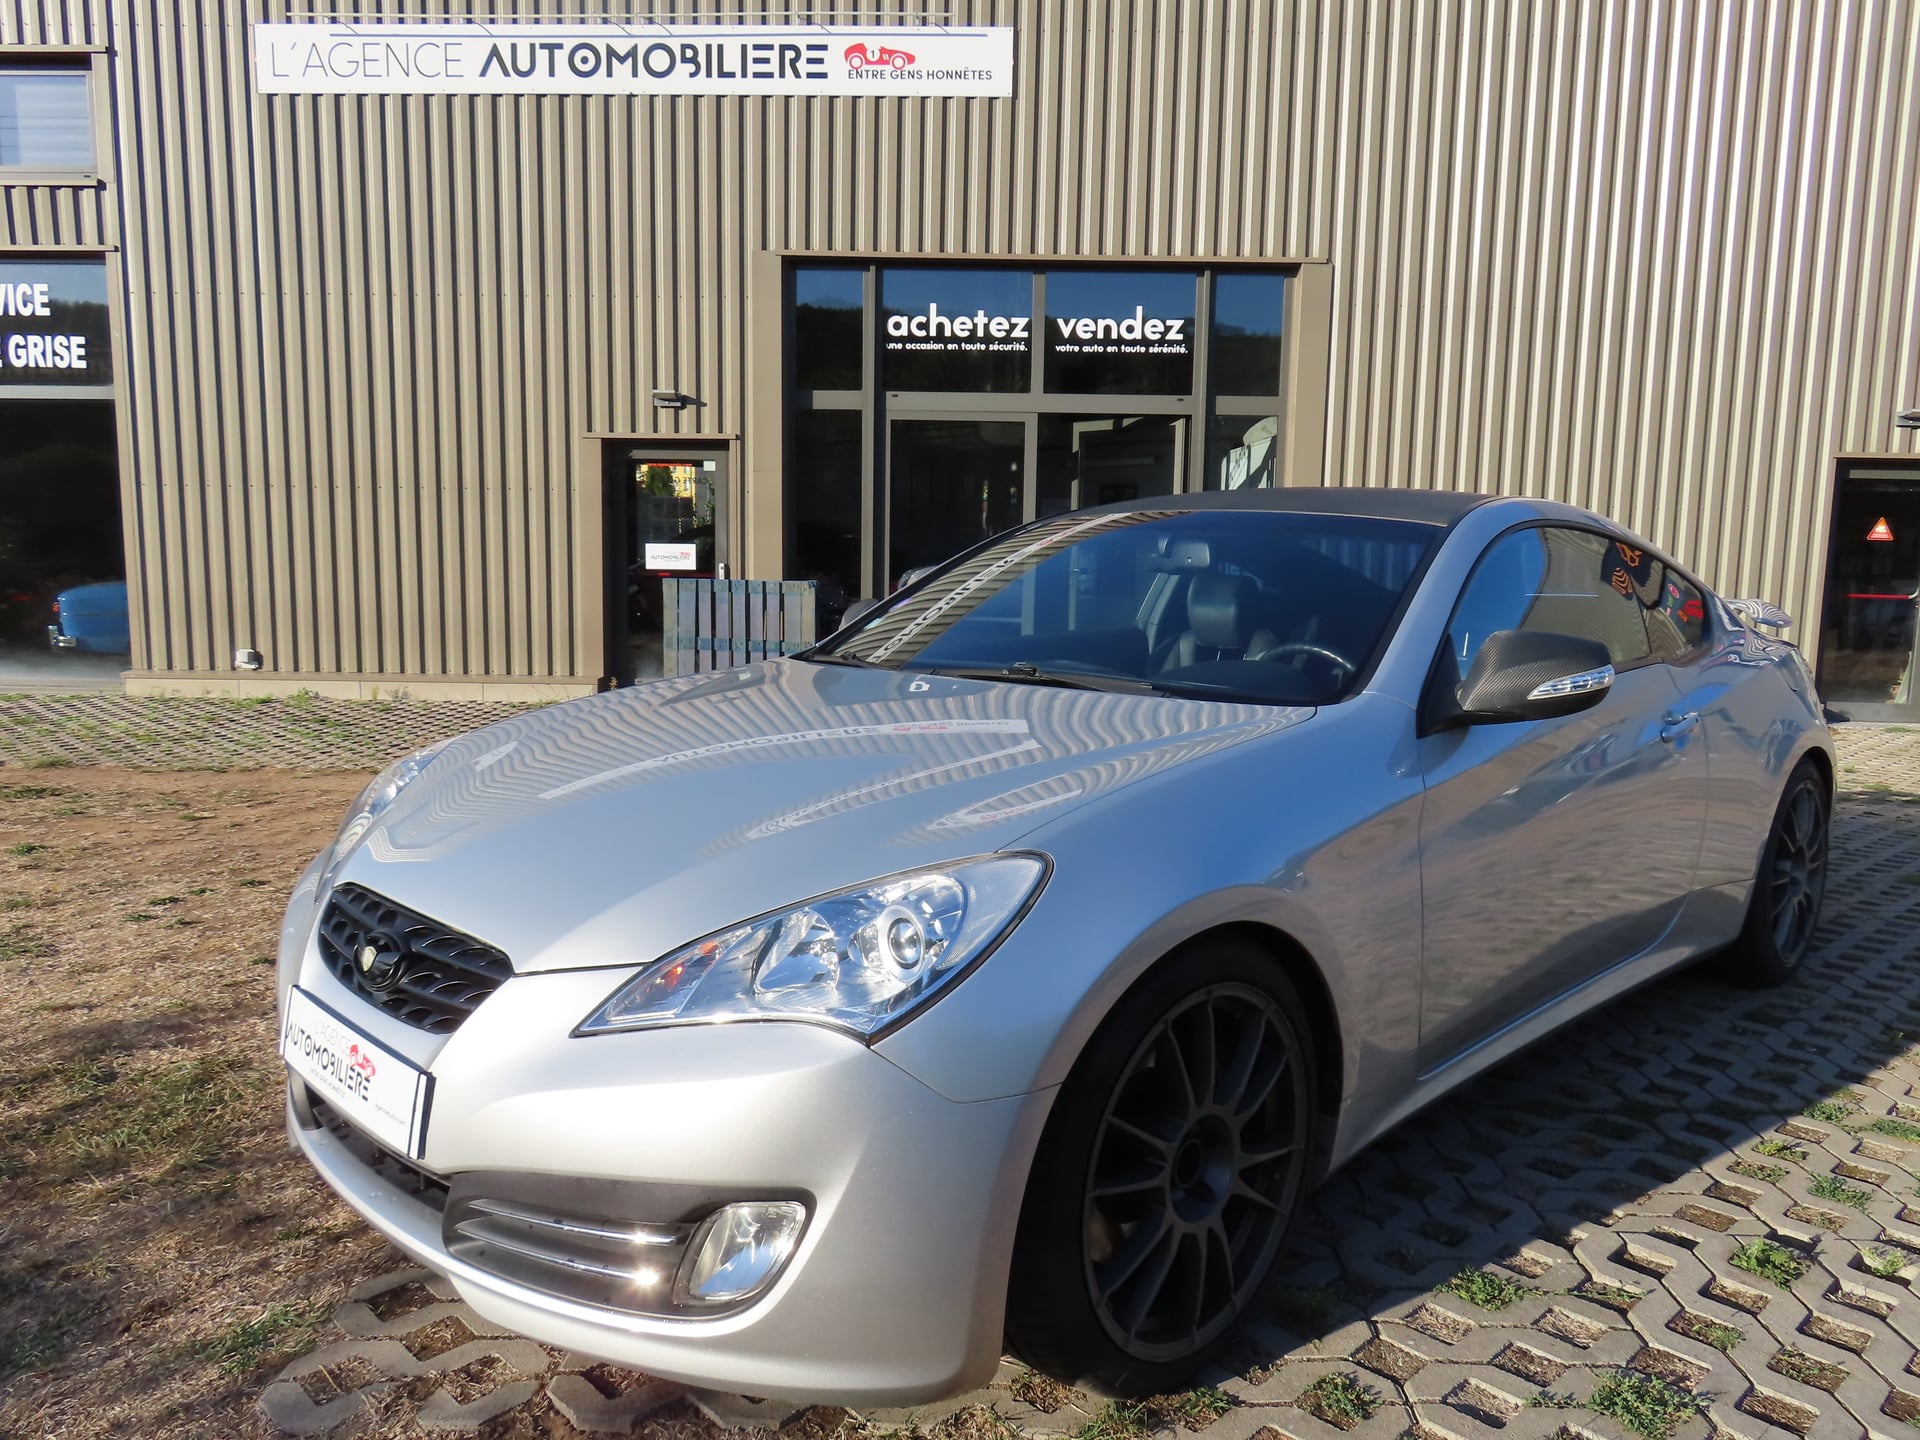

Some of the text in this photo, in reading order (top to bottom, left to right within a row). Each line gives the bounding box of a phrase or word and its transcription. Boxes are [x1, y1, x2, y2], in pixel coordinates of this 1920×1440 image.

[271, 42, 829, 79] L'AGENCE AUTOMOBILIERE
[848, 66, 993, 81] ENTRE GENS HONNÊTES
[887, 303, 1030, 338] achetez
[1056, 305, 1185, 341] vendez
[8, 334, 87, 369] GRISE
[886, 340, 1029, 352] une occasion en toute sécurité.
[1055, 343, 1189, 355] votre auto en toute sérénité.
[285, 1021, 372, 1103] AUTOMOBILIERE
